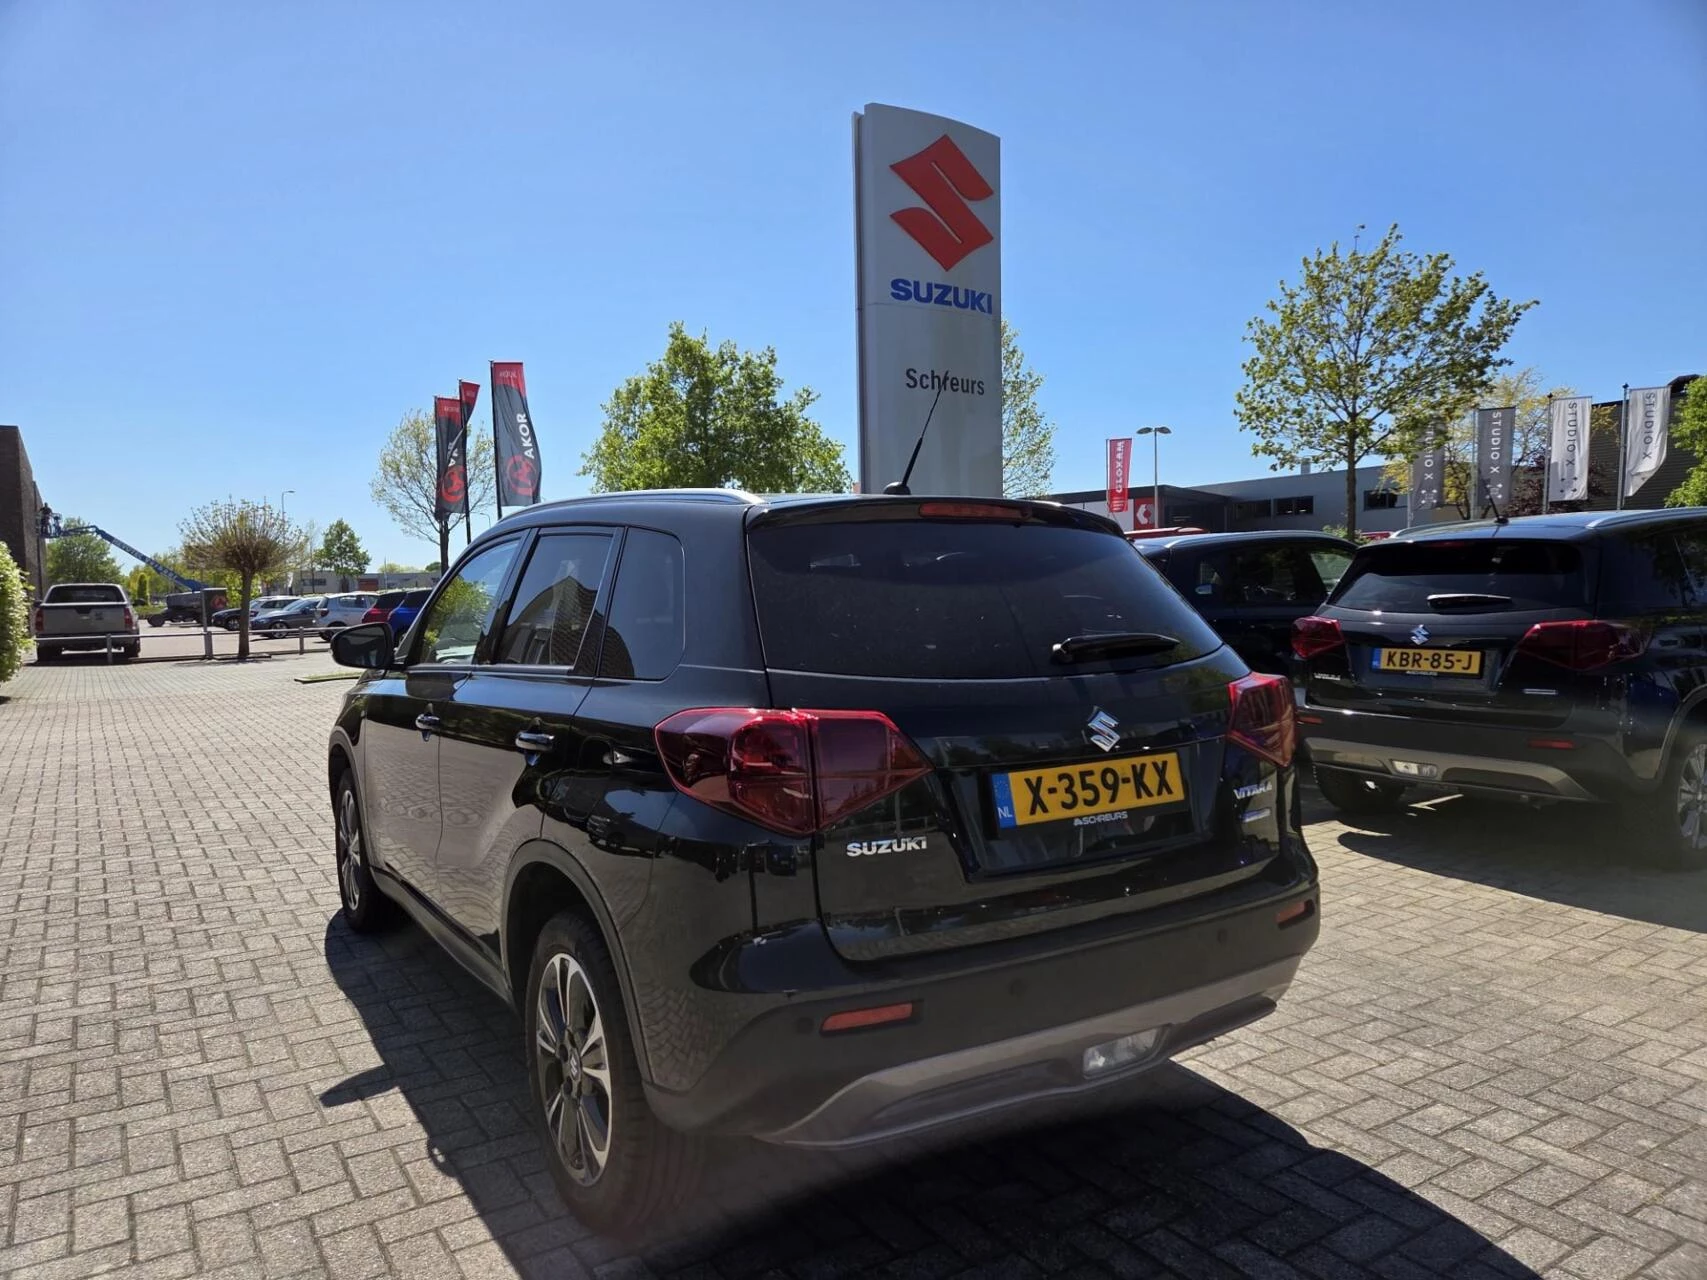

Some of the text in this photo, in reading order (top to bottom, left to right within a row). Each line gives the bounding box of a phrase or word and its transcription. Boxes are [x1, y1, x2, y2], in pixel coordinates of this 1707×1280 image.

[890, 278, 993, 315] SUZUKI
[905, 367, 985, 396] Schreurs
[516, 413, 535, 460] AKOR
[1489, 411, 1502, 474] STUDIO X
[1565, 401, 1577, 467] STUDIO X
[1642, 392, 1656, 460] STUDIO X
[1424, 472, 1434, 480] X
[1386, 651, 1473, 671] KBR-85-J
[1024, 760, 1174, 816] X-359-KX
[997, 806, 1013, 819] NL
[846, 836, 927, 857] SUZUKI
